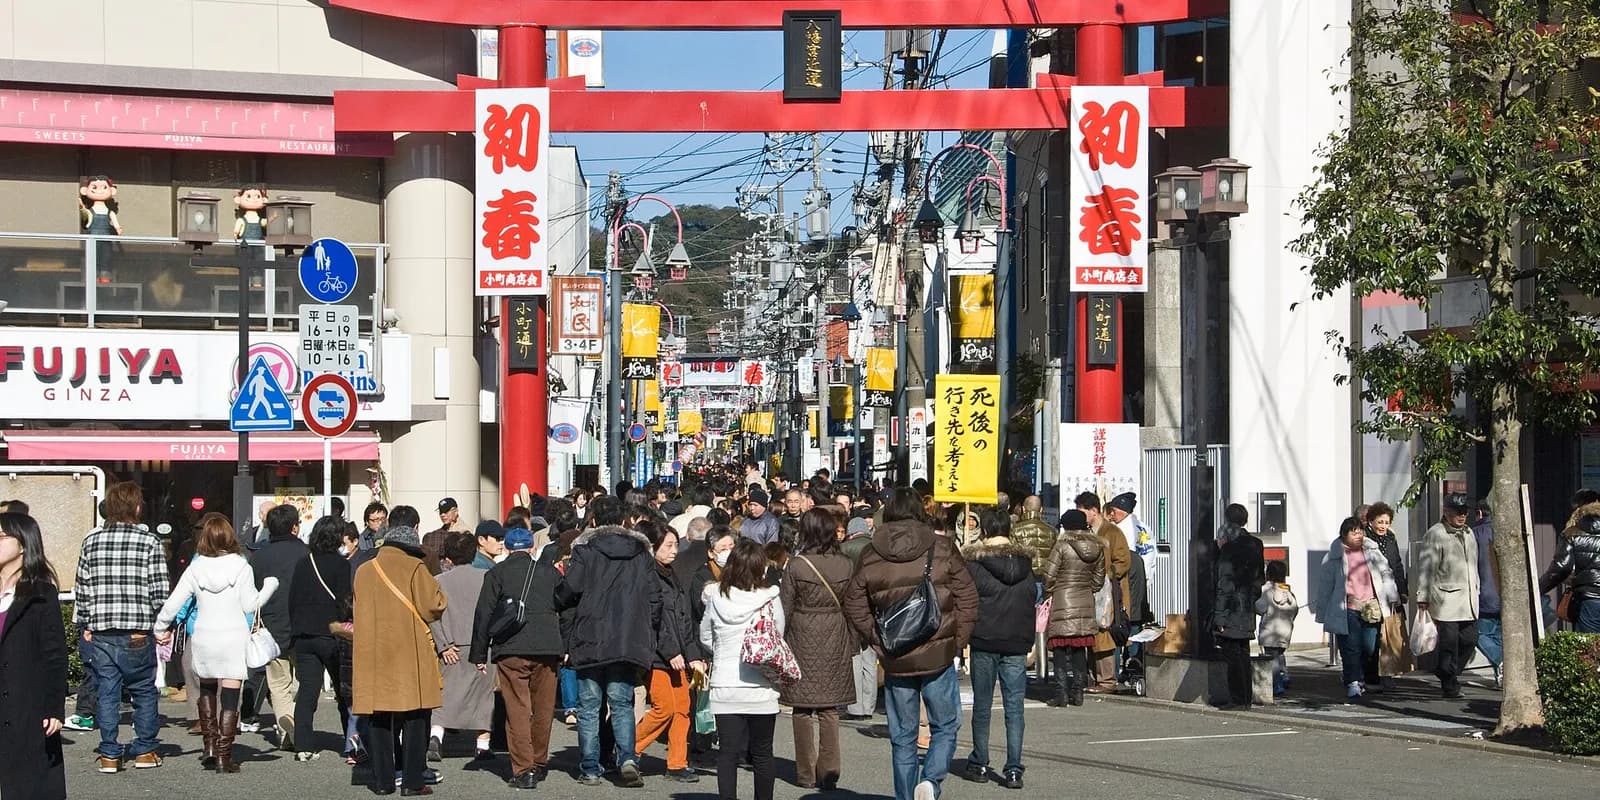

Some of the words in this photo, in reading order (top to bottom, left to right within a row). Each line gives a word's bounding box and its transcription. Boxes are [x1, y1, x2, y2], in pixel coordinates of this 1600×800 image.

[34, 131, 86, 141] SWEETS
[280, 141, 351, 153] RESTAURANT
[482, 104, 541, 260] 初春
[1079, 101, 1141, 256] 初春
[485, 272, 538, 287] 小町商店会
[1081, 269, 1139, 283] 小町商店会
[309, 311, 350, 322] 平日の
[515, 302, 534, 360] 小町通り
[1095, 298, 1111, 356] 小町通り
[0, 346, 182, 387] FUJIYA
[43, 388, 131, 401] GINZA
[944, 386, 965, 493] 行き先を考えよ
[968, 387, 995, 450] 死後の
[170, 444, 226, 454] FUJIYA
[911, 427, 922, 470] ホテル
[1093, 428, 1106, 476] 謹賀新年
